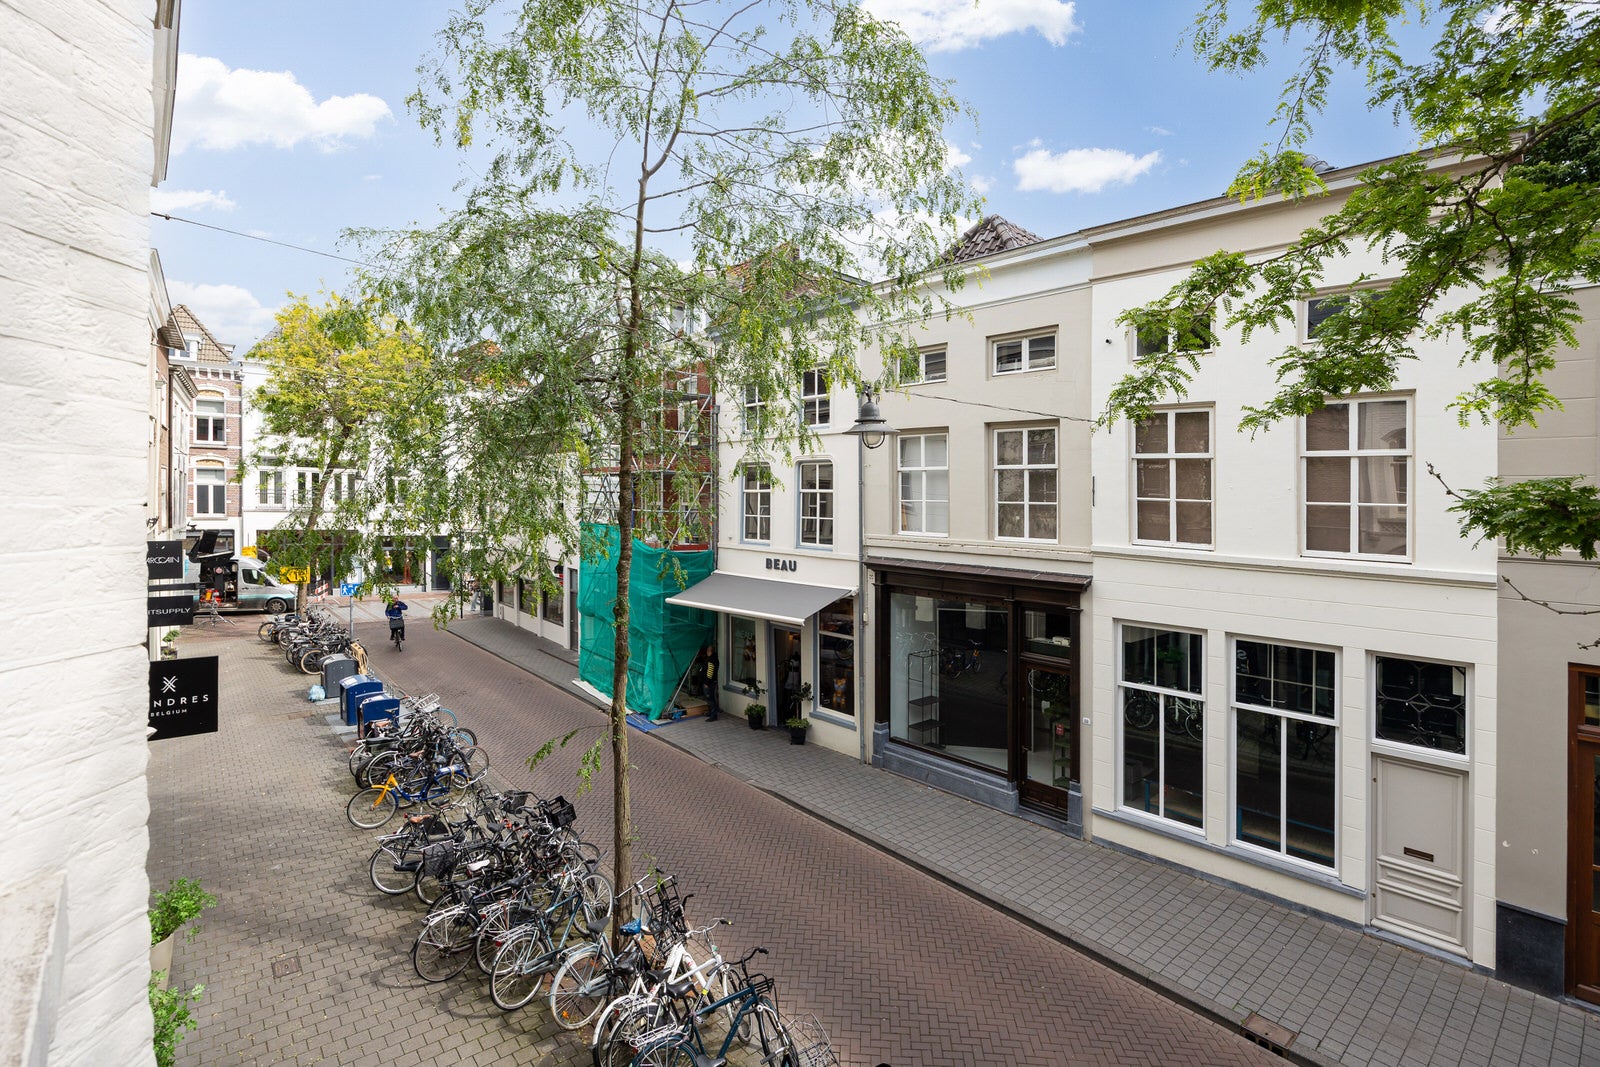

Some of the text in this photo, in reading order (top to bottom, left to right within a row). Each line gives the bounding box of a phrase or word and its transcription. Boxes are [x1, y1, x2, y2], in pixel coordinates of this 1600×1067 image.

[765, 557, 797, 572] BEAU
[153, 694, 209, 708] NDRES
[150, 709, 187, 718] BELGIUM
